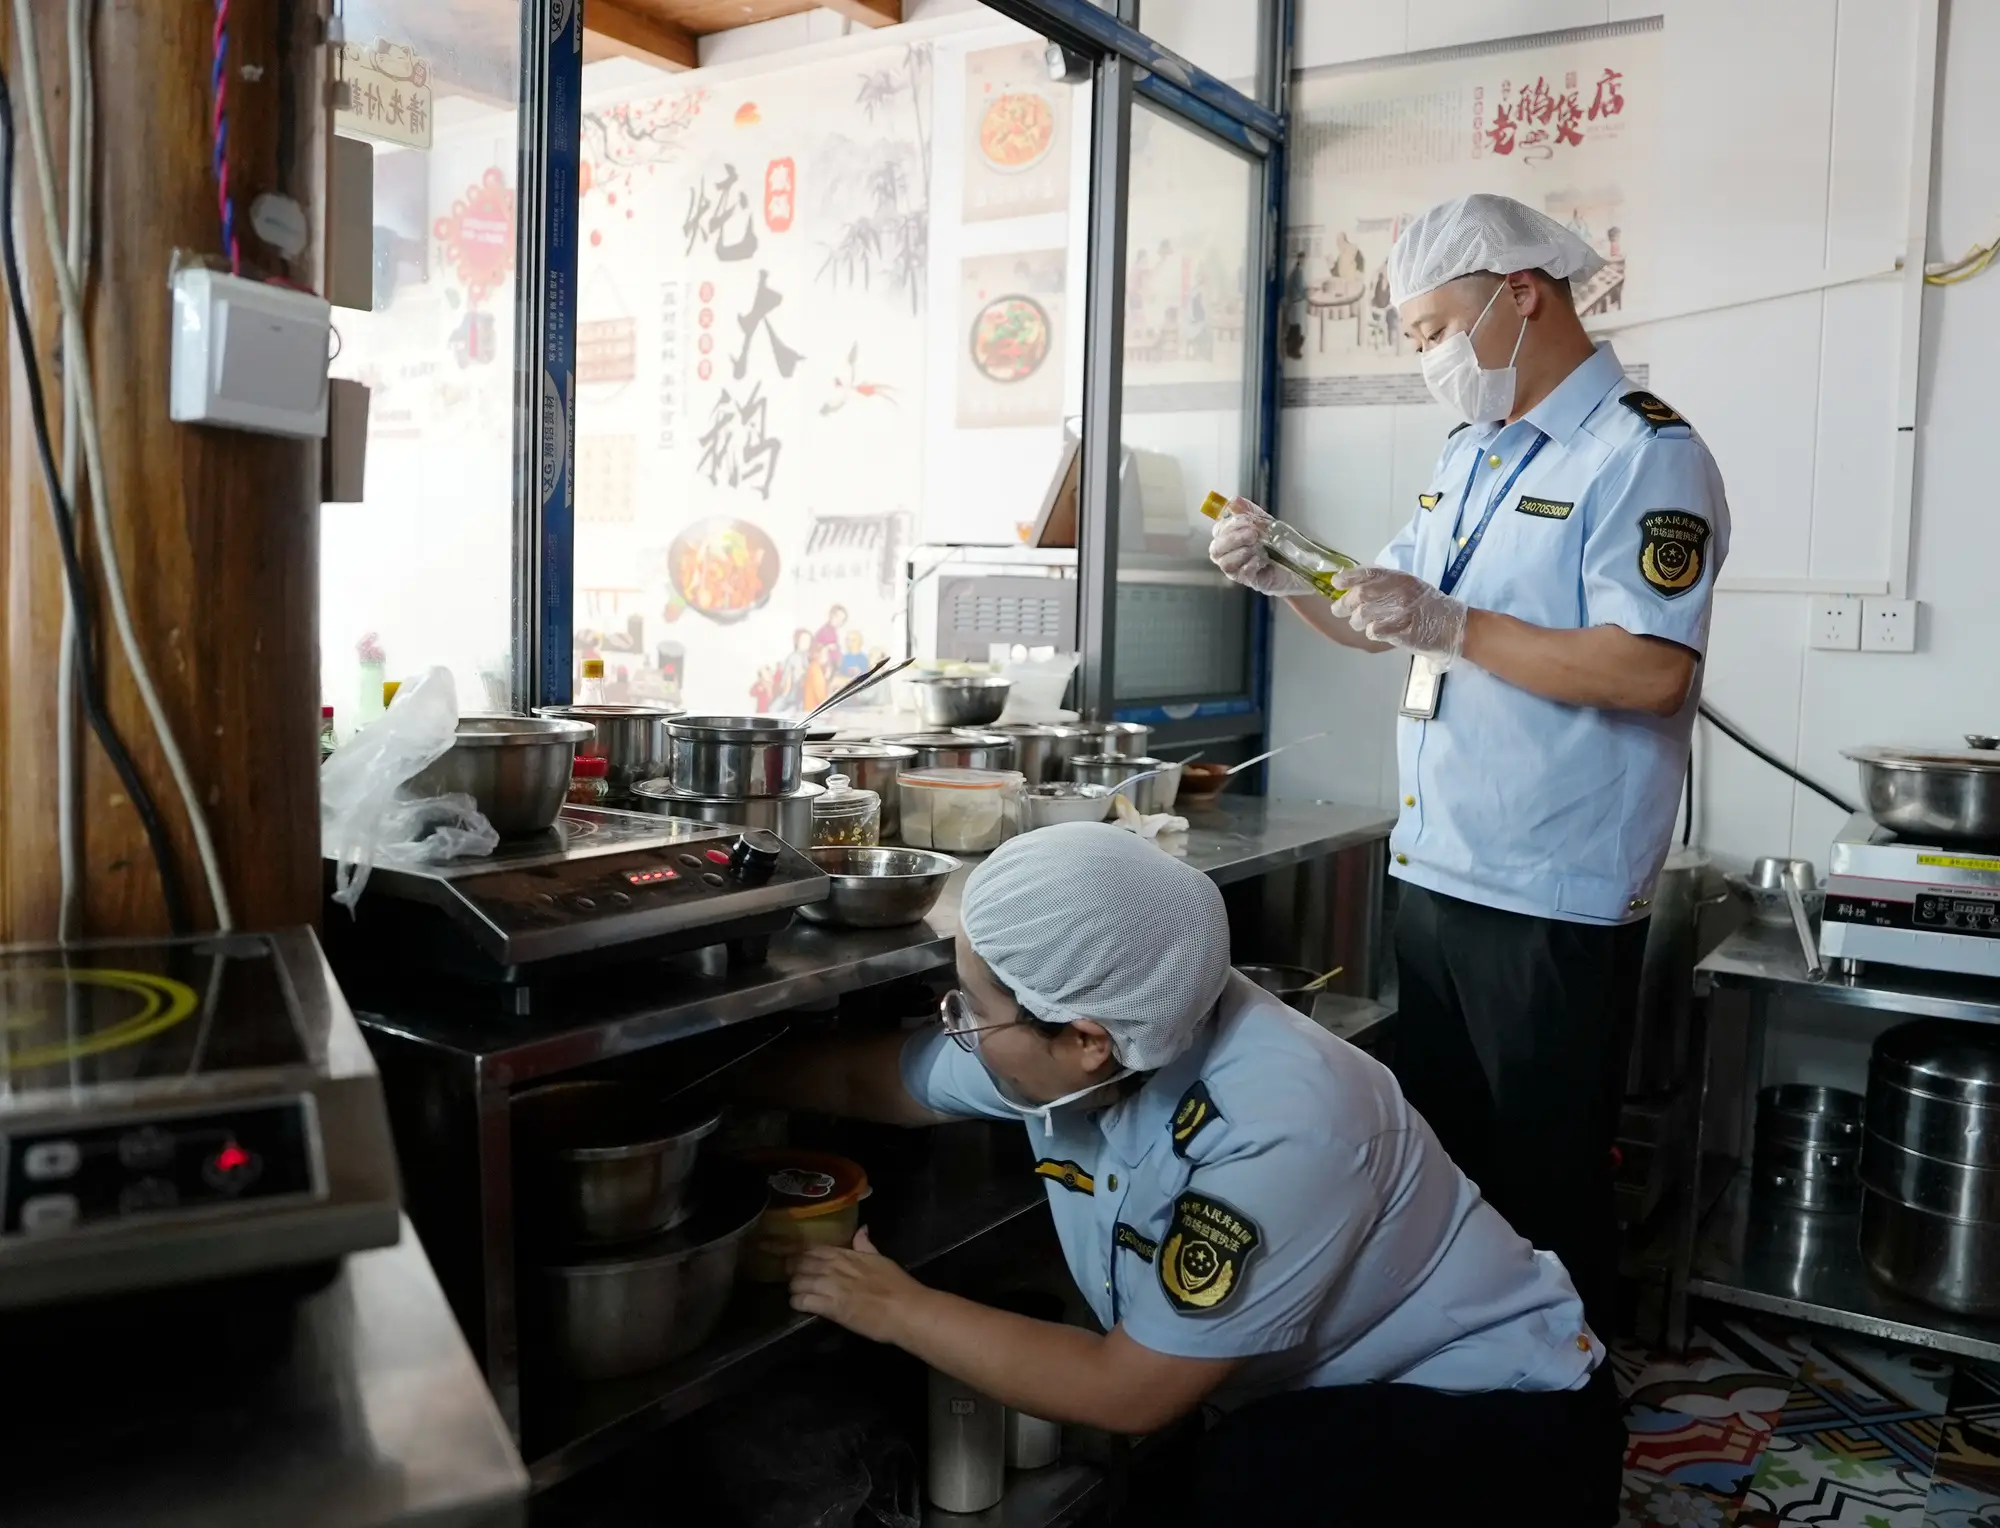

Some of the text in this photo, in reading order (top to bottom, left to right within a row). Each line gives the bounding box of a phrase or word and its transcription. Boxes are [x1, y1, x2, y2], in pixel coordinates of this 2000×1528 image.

[1645, 515, 1705, 536] 中华人民共和国
[1650, 527, 1699, 543] 市场监管执法
[1181, 1202, 1252, 1244] 中华人民共和国
[1182, 1215, 1240, 1253] 市场监管执法
